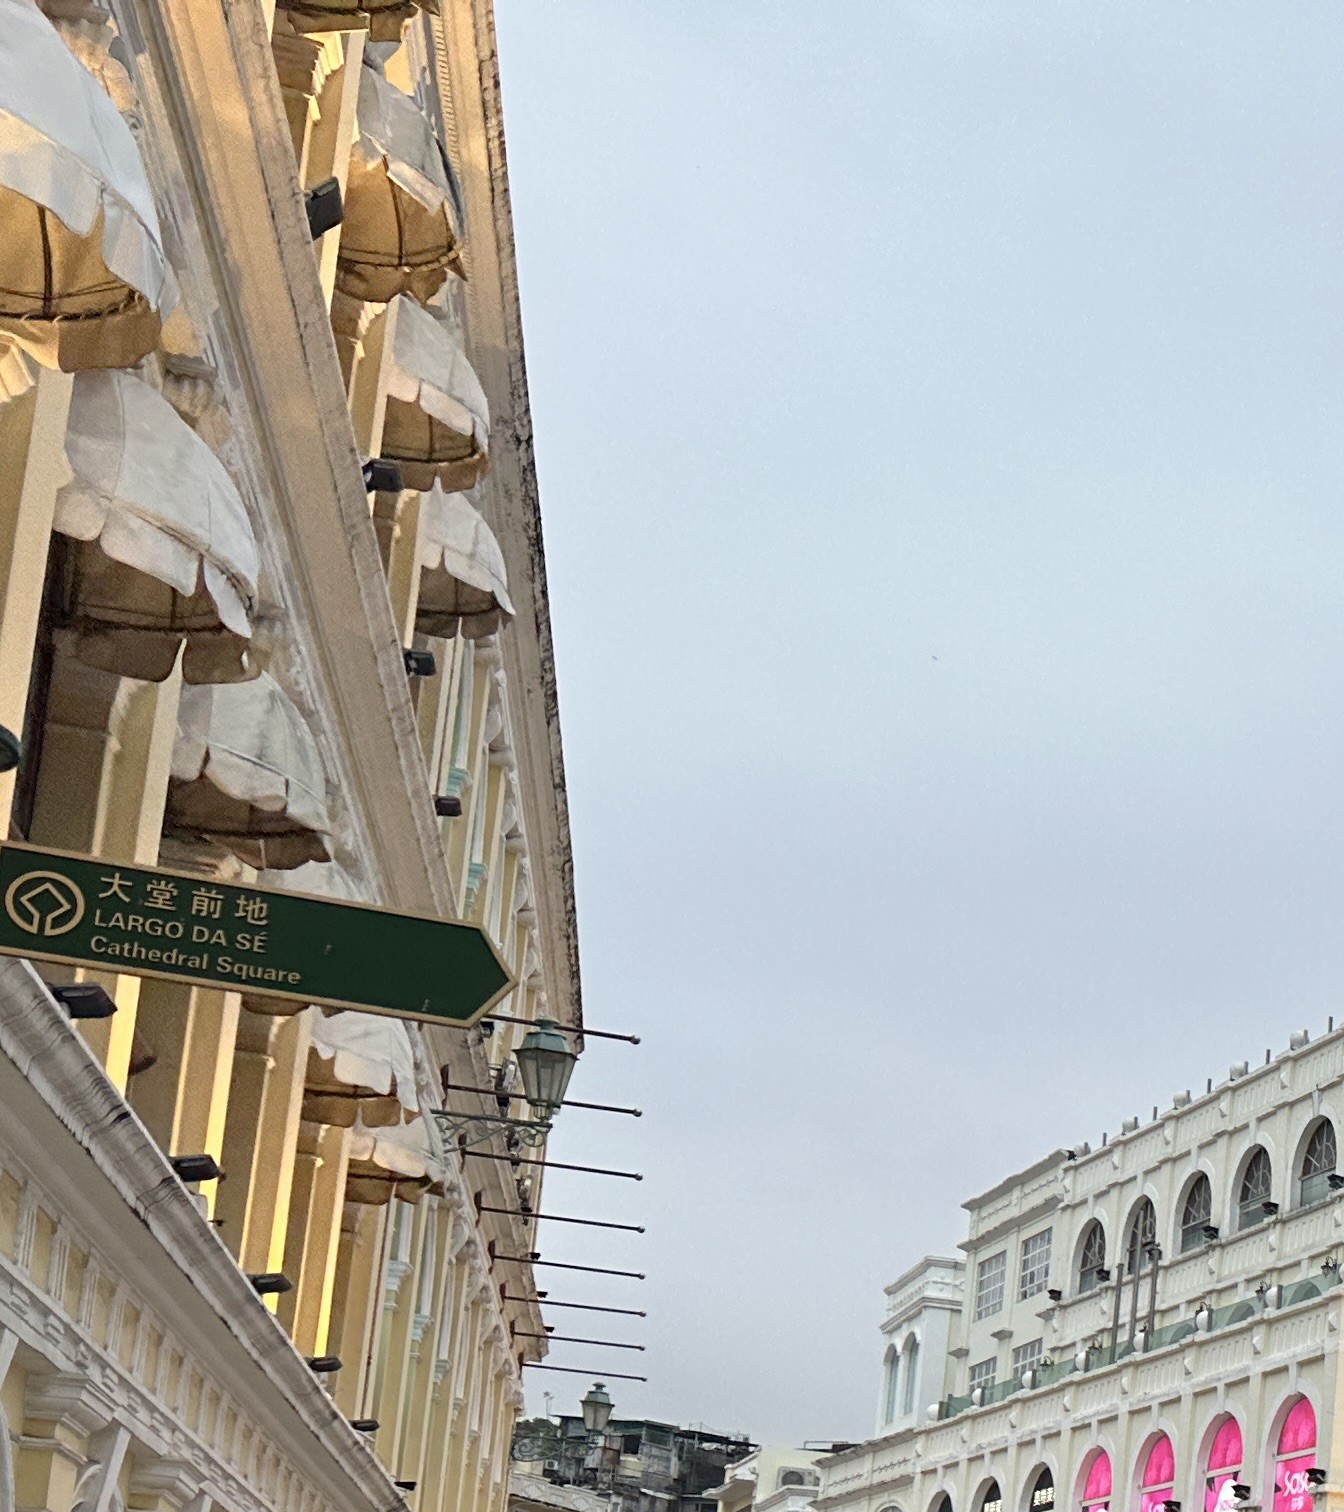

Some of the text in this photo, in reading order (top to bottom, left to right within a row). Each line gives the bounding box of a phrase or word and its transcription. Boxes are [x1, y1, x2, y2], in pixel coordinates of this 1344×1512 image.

[97, 872, 269, 926] 大堂前地
[94, 908, 269, 954] LARGO DA SÉ
[90, 934, 301, 986] Cathedral Square
